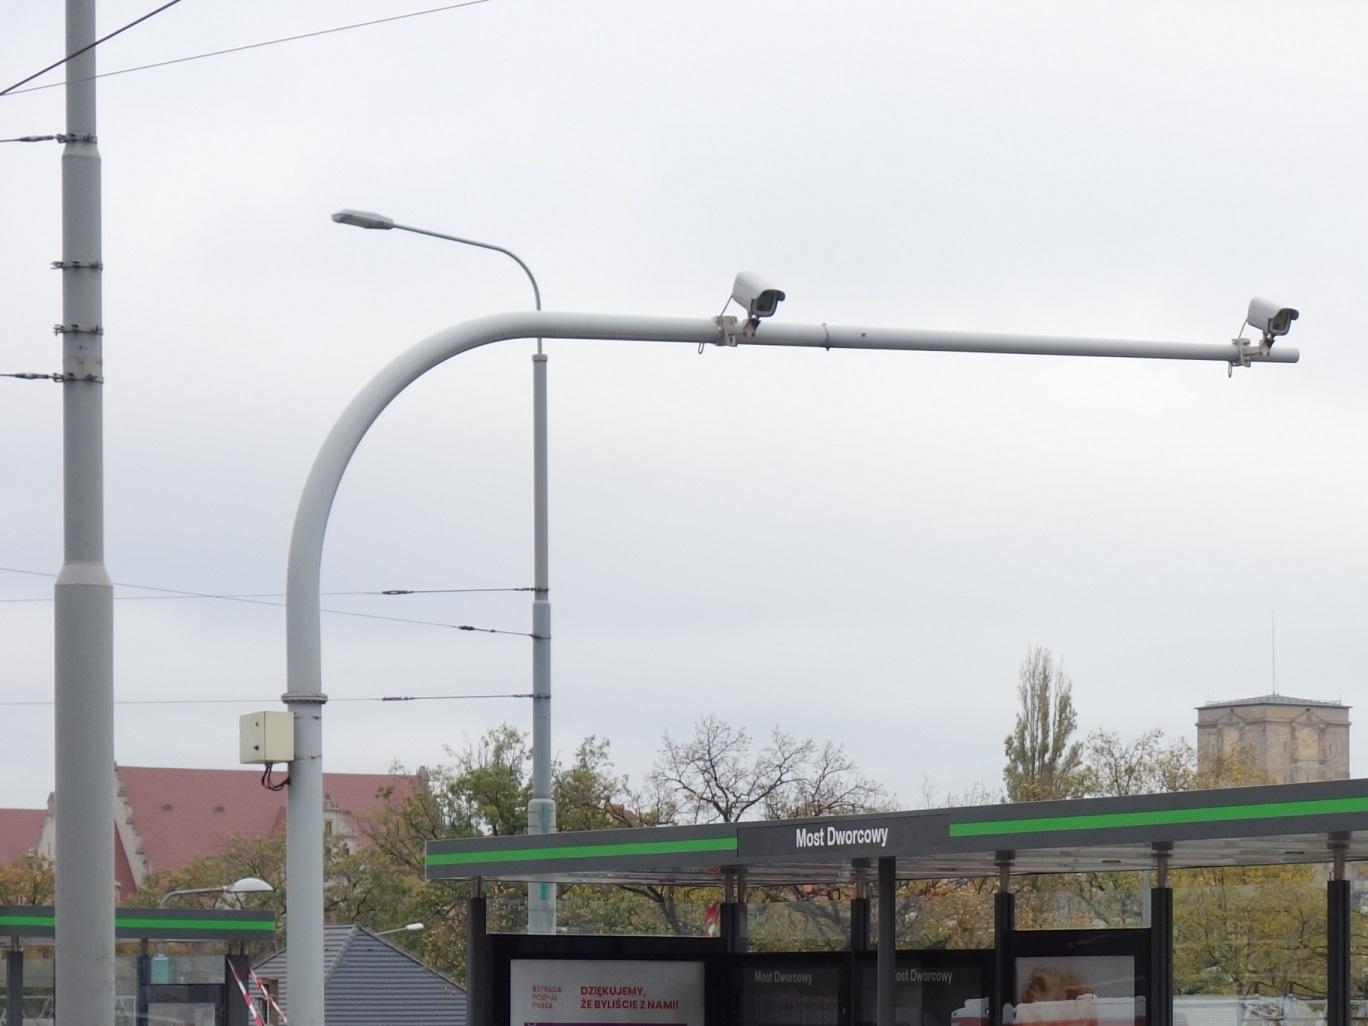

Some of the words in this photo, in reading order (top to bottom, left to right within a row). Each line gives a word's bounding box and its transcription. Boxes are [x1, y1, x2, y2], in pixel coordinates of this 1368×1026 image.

[796, 828, 825, 848] Most
[827, 826, 889, 848] Dworcowy
[754, 970, 773, 984] Most
[774, 970, 813, 986] Dworcowy
[895, 970, 909, 982] ost
[910, 968, 953, 985] Dworcowy
[580, 985, 646, 997] DZIĘKUJEMY,
[580, 998, 592, 1009] ŻE
[594, 998, 638, 1009] BYLIŚCIE
[639, 1000, 646, 1009] Z
[647, 1000, 679, 1010] NAMI!
